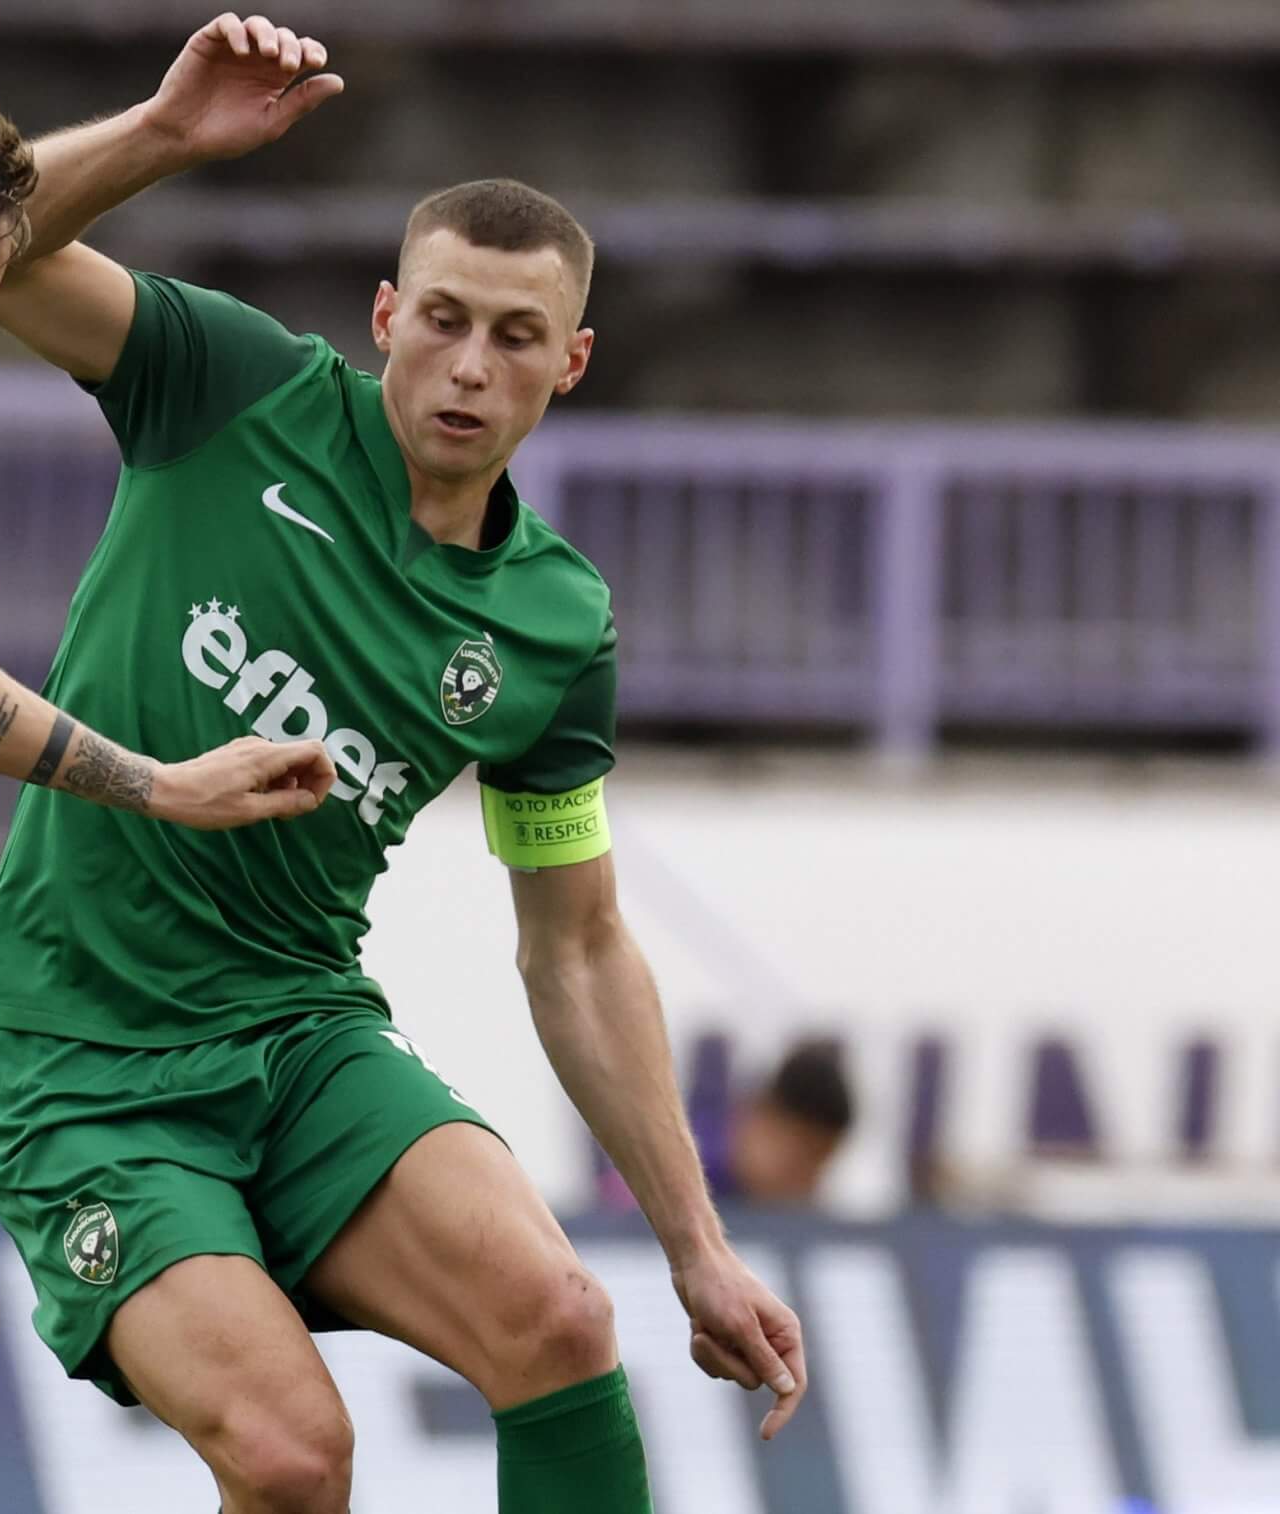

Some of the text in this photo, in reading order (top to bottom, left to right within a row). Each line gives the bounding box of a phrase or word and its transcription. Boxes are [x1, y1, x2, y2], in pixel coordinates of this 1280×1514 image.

[181, 612, 411, 827] efbet
[527, 798, 547, 813] TO
[534, 815, 599, 842] RESPECT
